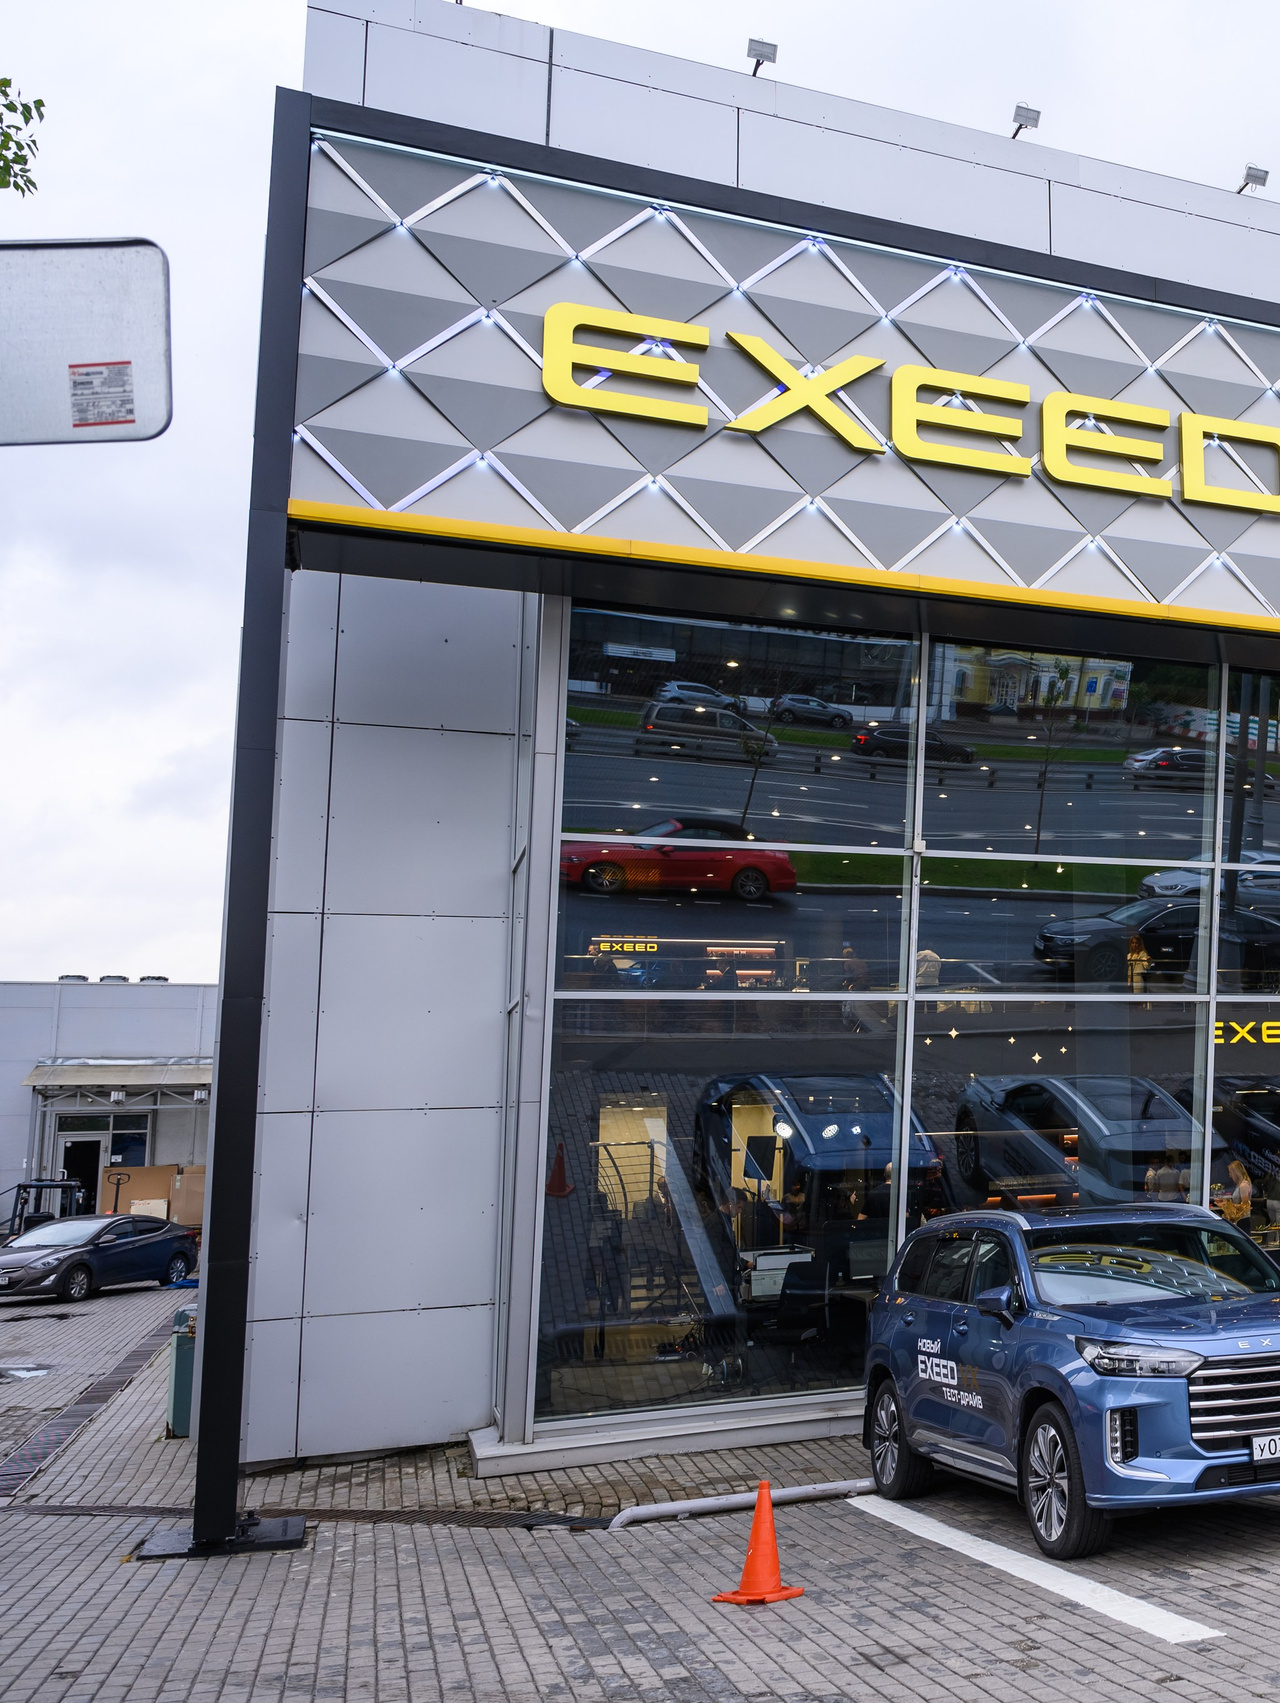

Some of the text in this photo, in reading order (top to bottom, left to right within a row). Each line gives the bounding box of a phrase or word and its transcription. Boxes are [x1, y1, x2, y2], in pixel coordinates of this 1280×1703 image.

[600, 942, 658, 952] EXEED
[917, 1337, 941, 1354] НОВЫЙ
[917, 1354, 958, 1386] EXEED
[942, 1387, 984, 1409] ТЕСТ-ДРАЙВ
